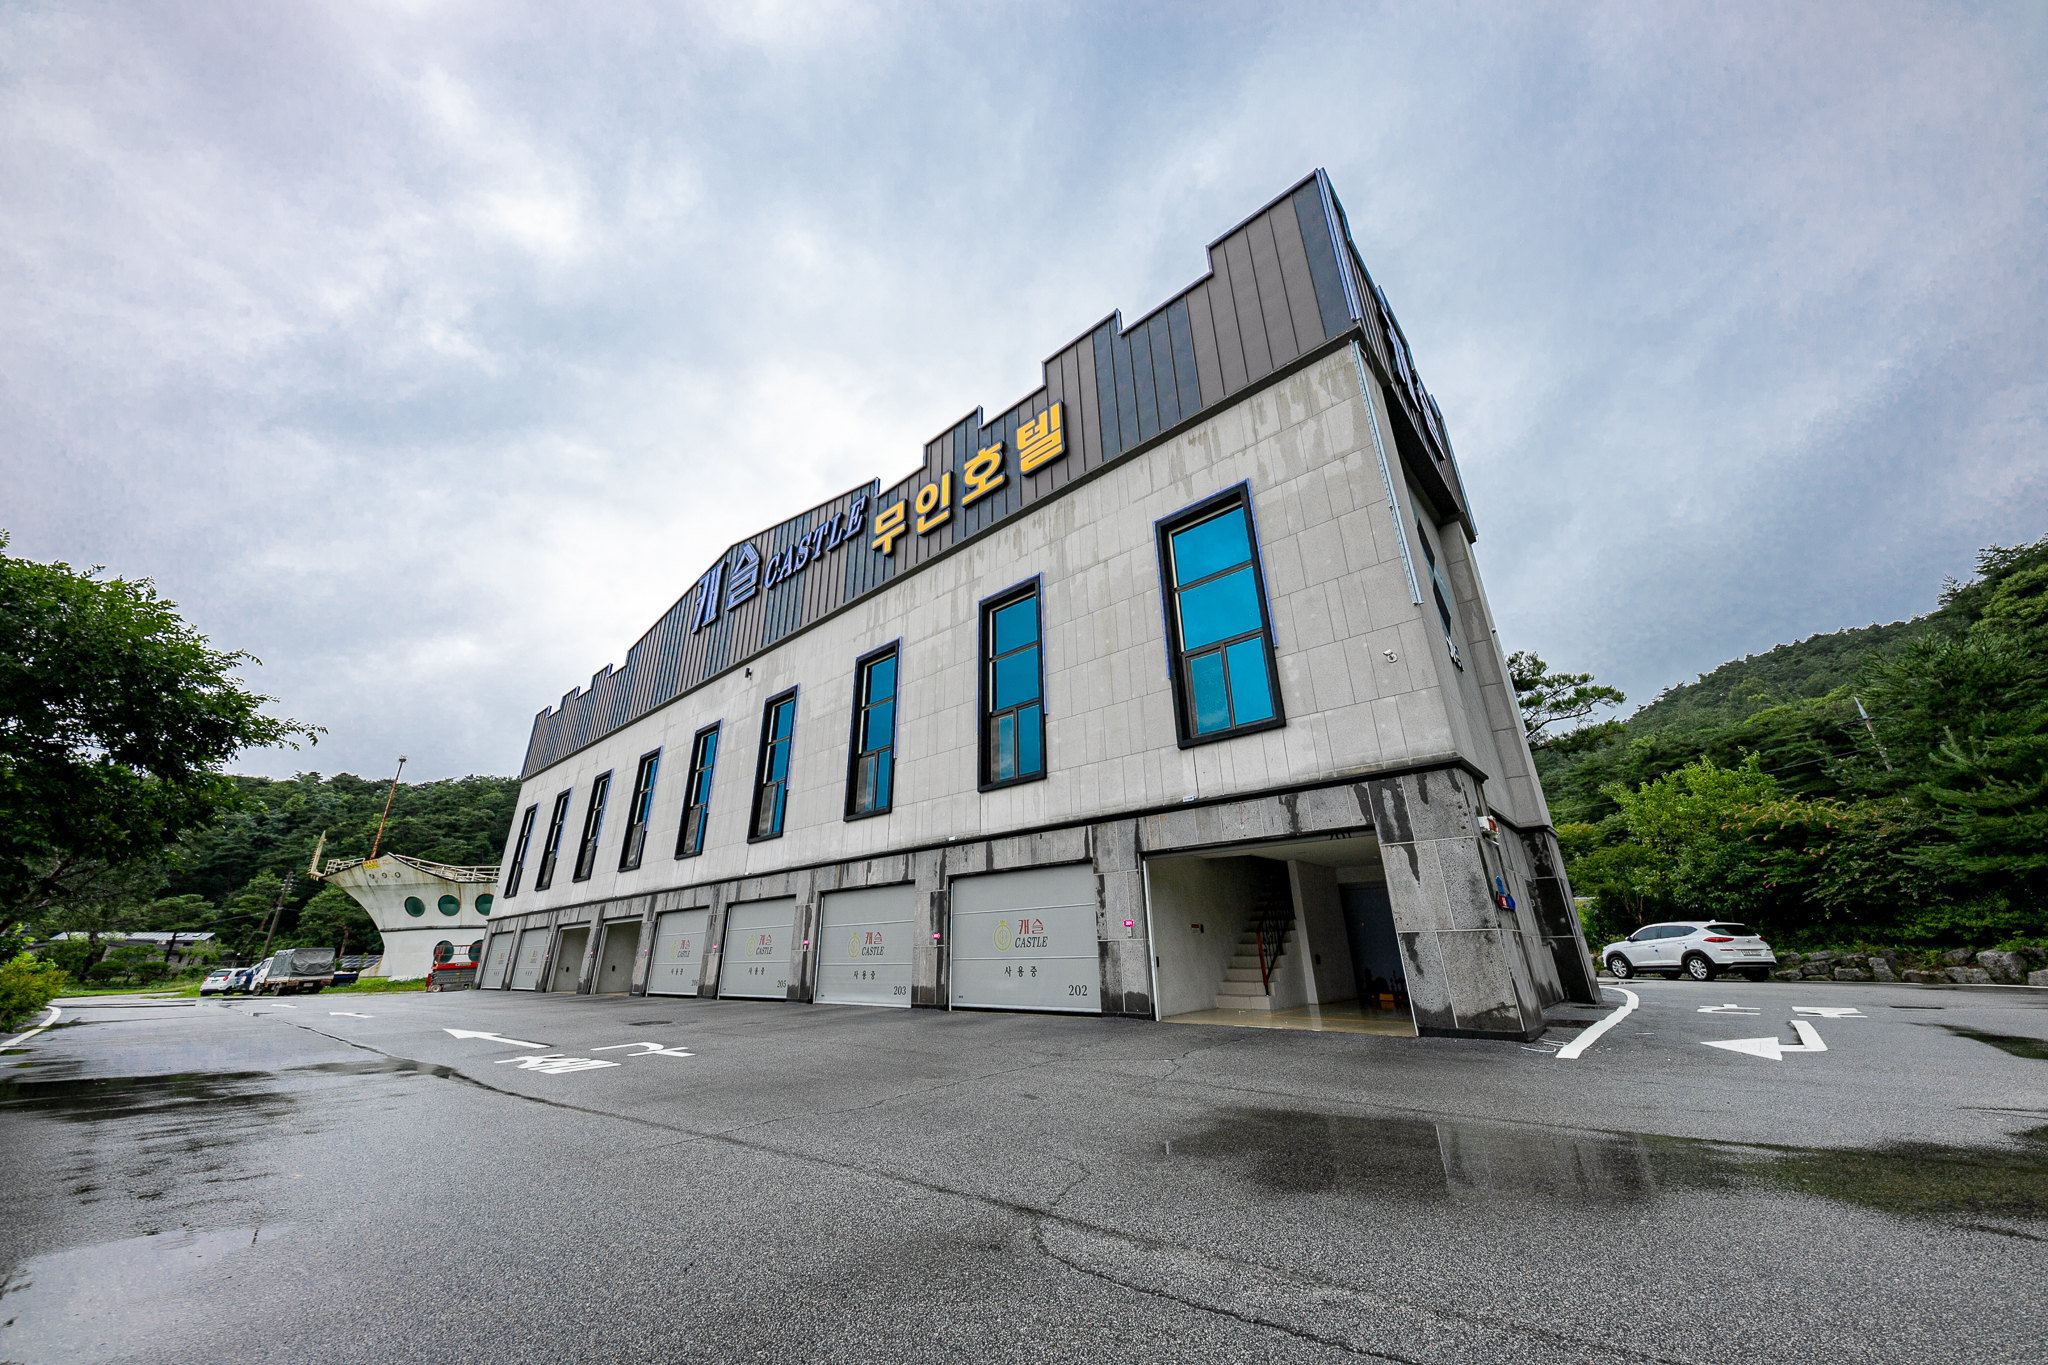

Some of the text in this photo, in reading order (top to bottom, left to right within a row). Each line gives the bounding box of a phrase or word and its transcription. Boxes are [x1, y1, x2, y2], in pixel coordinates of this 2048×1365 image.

[691, 399, 1065, 635] 캐슬 CASTLE 무인호텔
[1018, 918, 1044, 935] 캐슬
[865, 931, 882, 945] 캐슬
[1014, 936, 1048, 948] CASTLE
[756, 946, 773, 955] CASTLE
[861, 946, 885, 956] CASTLE
[777, 979, 787, 988] 205
[893, 985, 907, 996] 203
[1068, 984, 1088, 997] 202
